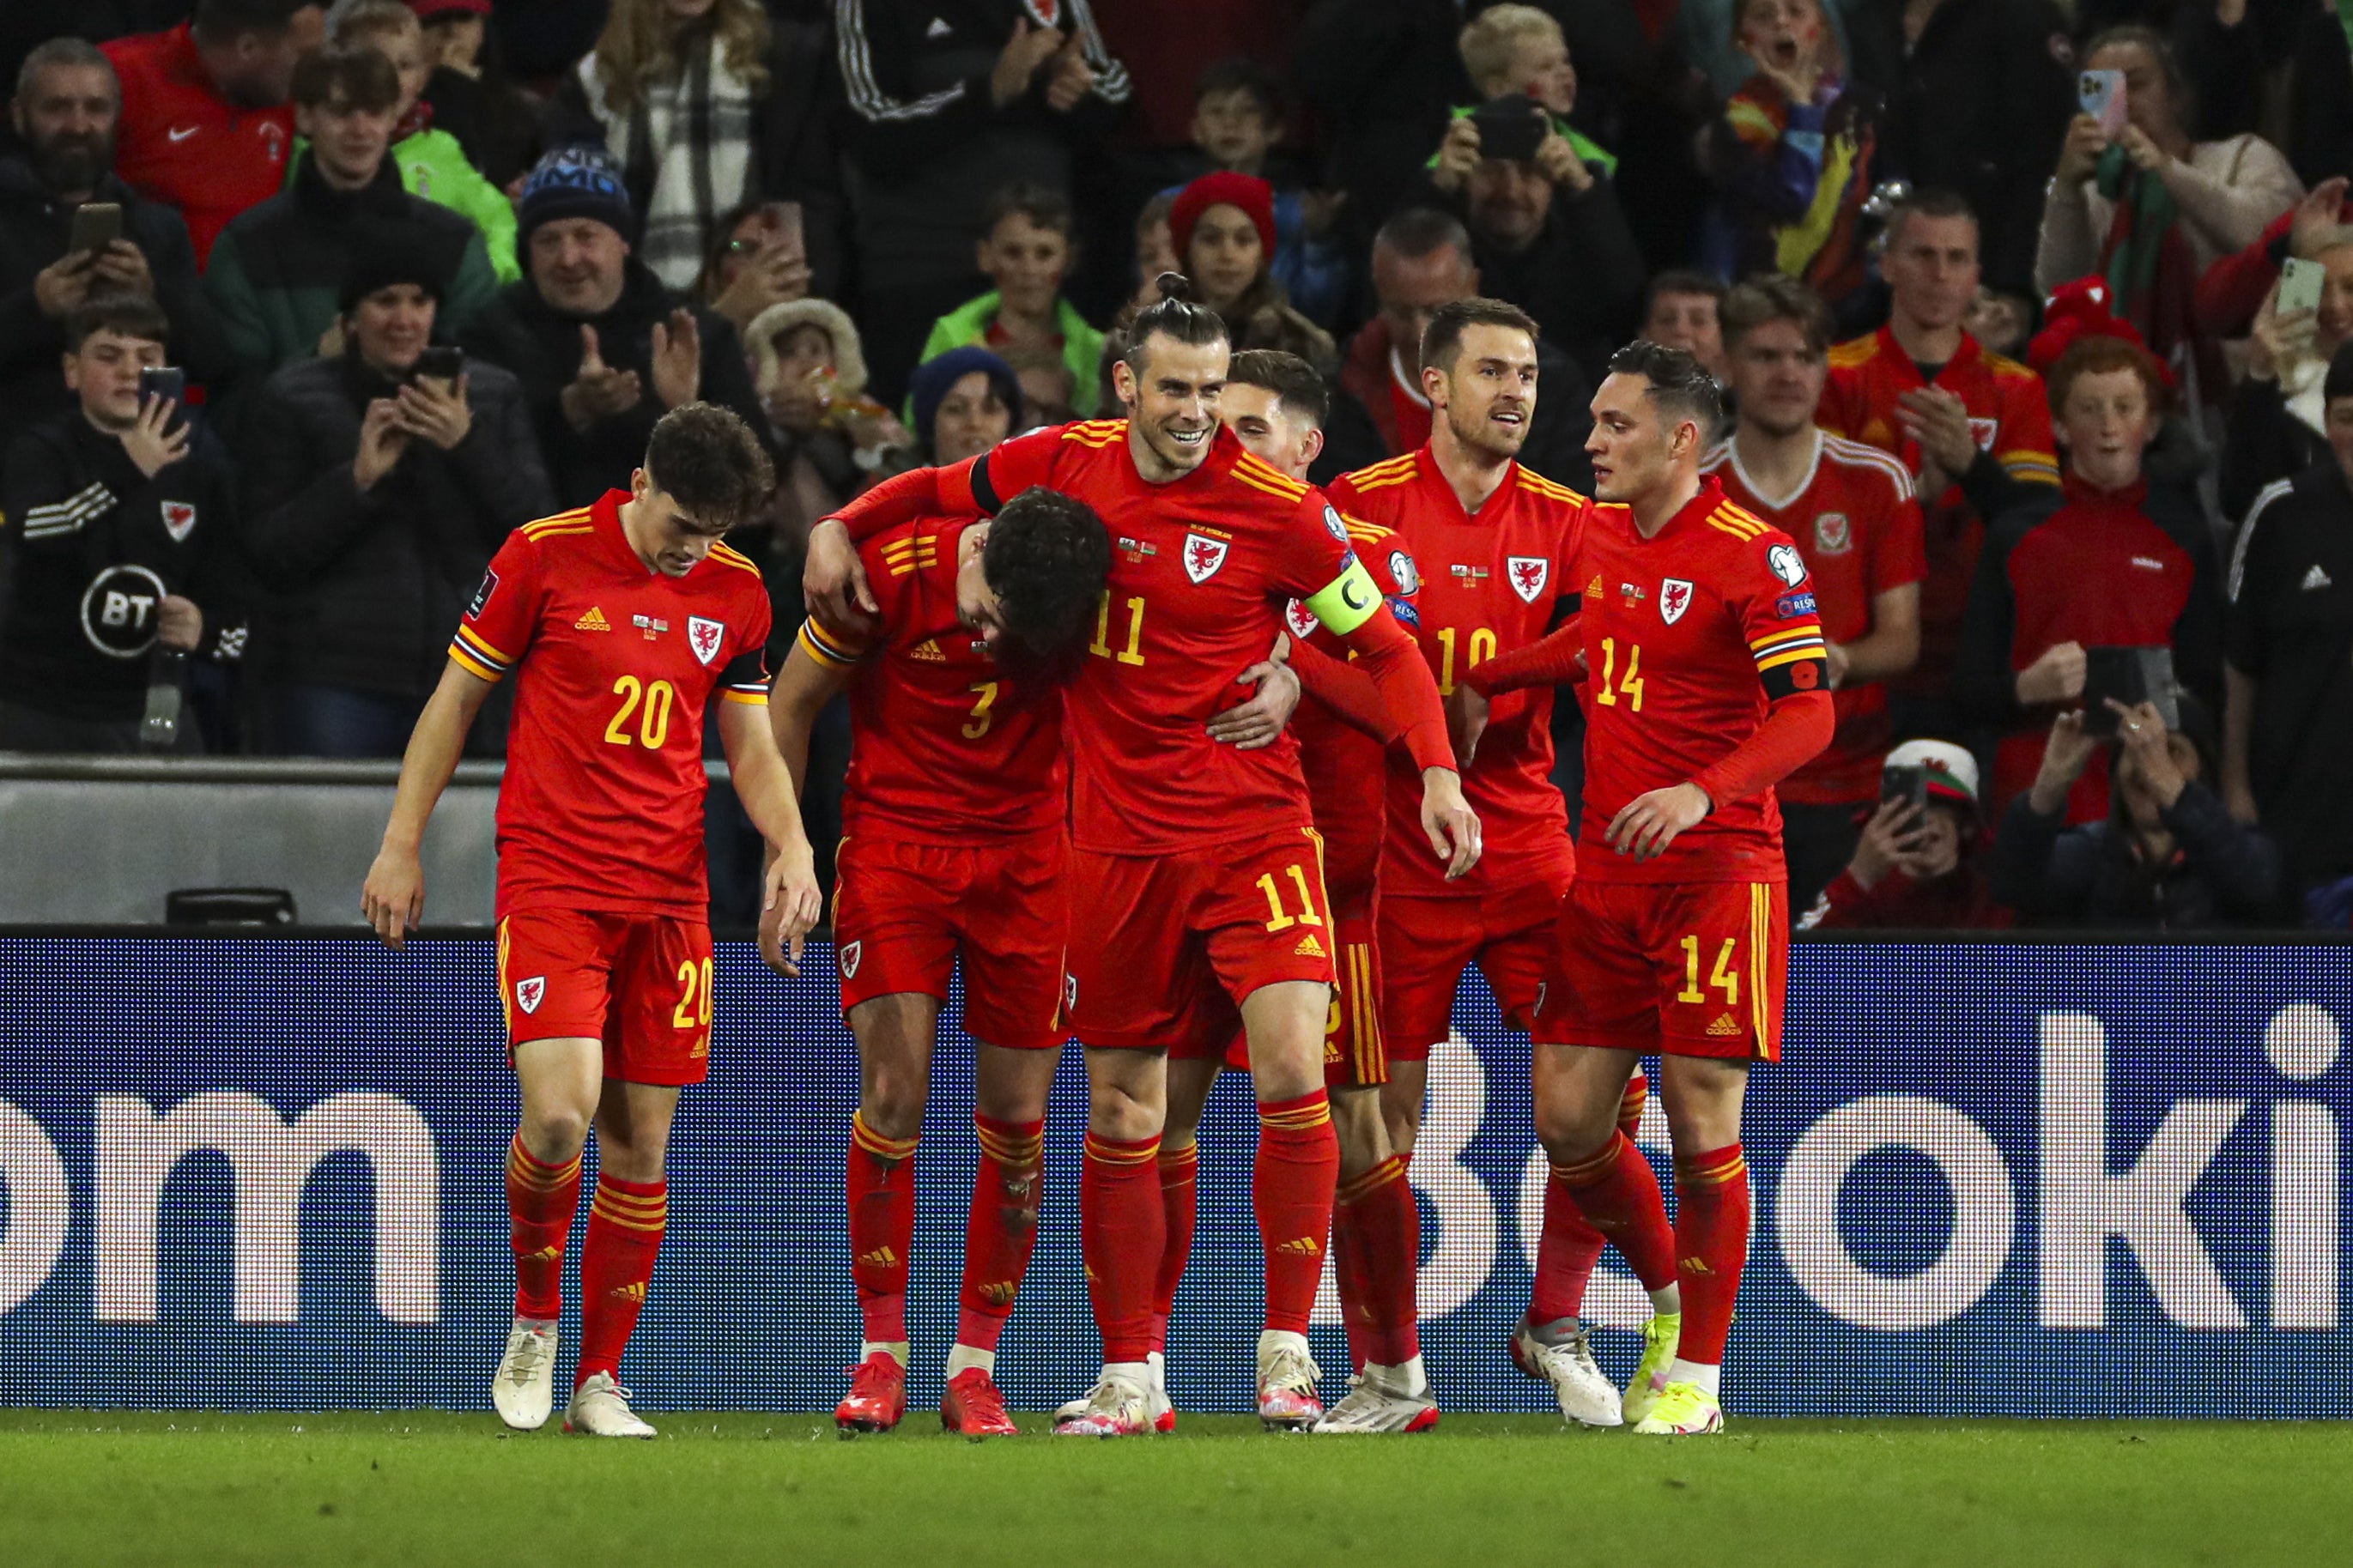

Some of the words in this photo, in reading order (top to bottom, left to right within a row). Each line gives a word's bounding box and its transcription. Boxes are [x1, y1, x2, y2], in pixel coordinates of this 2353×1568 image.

[101, 590, 155, 628] BT
[1341, 578, 1368, 610] C
[574, 622, 611, 632] adidas
[911, 652, 946, 662] adidas
[1089, 589, 1145, 666] 11
[1437, 627, 1497, 696] 10
[1598, 637, 1645, 712] 14
[604, 675, 674, 749] 20
[961, 682, 998, 739] 3
[1256, 864, 1323, 932] 11
[1295, 947, 1326, 958] adidas
[1677, 935, 1738, 1005] 14
[673, 956, 713, 1028] 20
[1706, 1026, 1742, 1035] adidas
